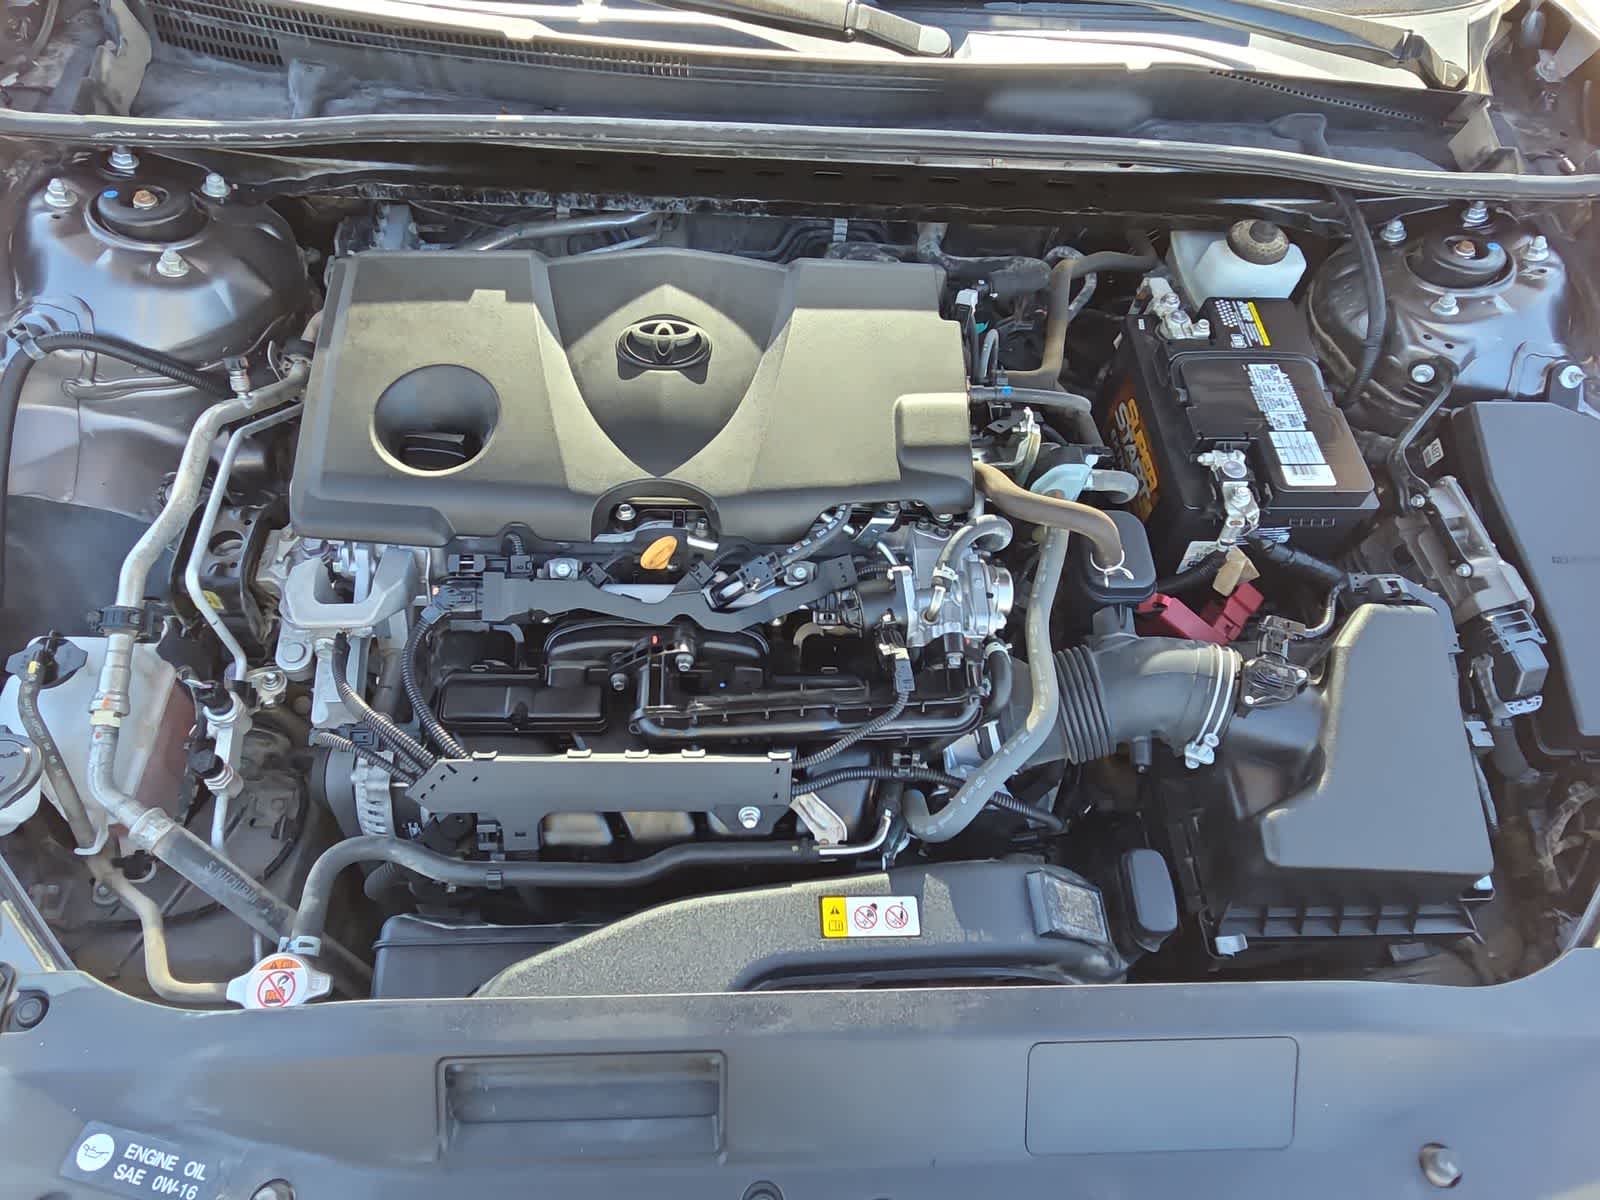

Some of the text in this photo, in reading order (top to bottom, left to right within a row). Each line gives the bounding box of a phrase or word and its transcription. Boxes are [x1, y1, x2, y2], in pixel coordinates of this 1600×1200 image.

[124, 1143, 206, 1181] ENGINE OIL
[113, 1164, 198, 1200] SAE 0W-16
